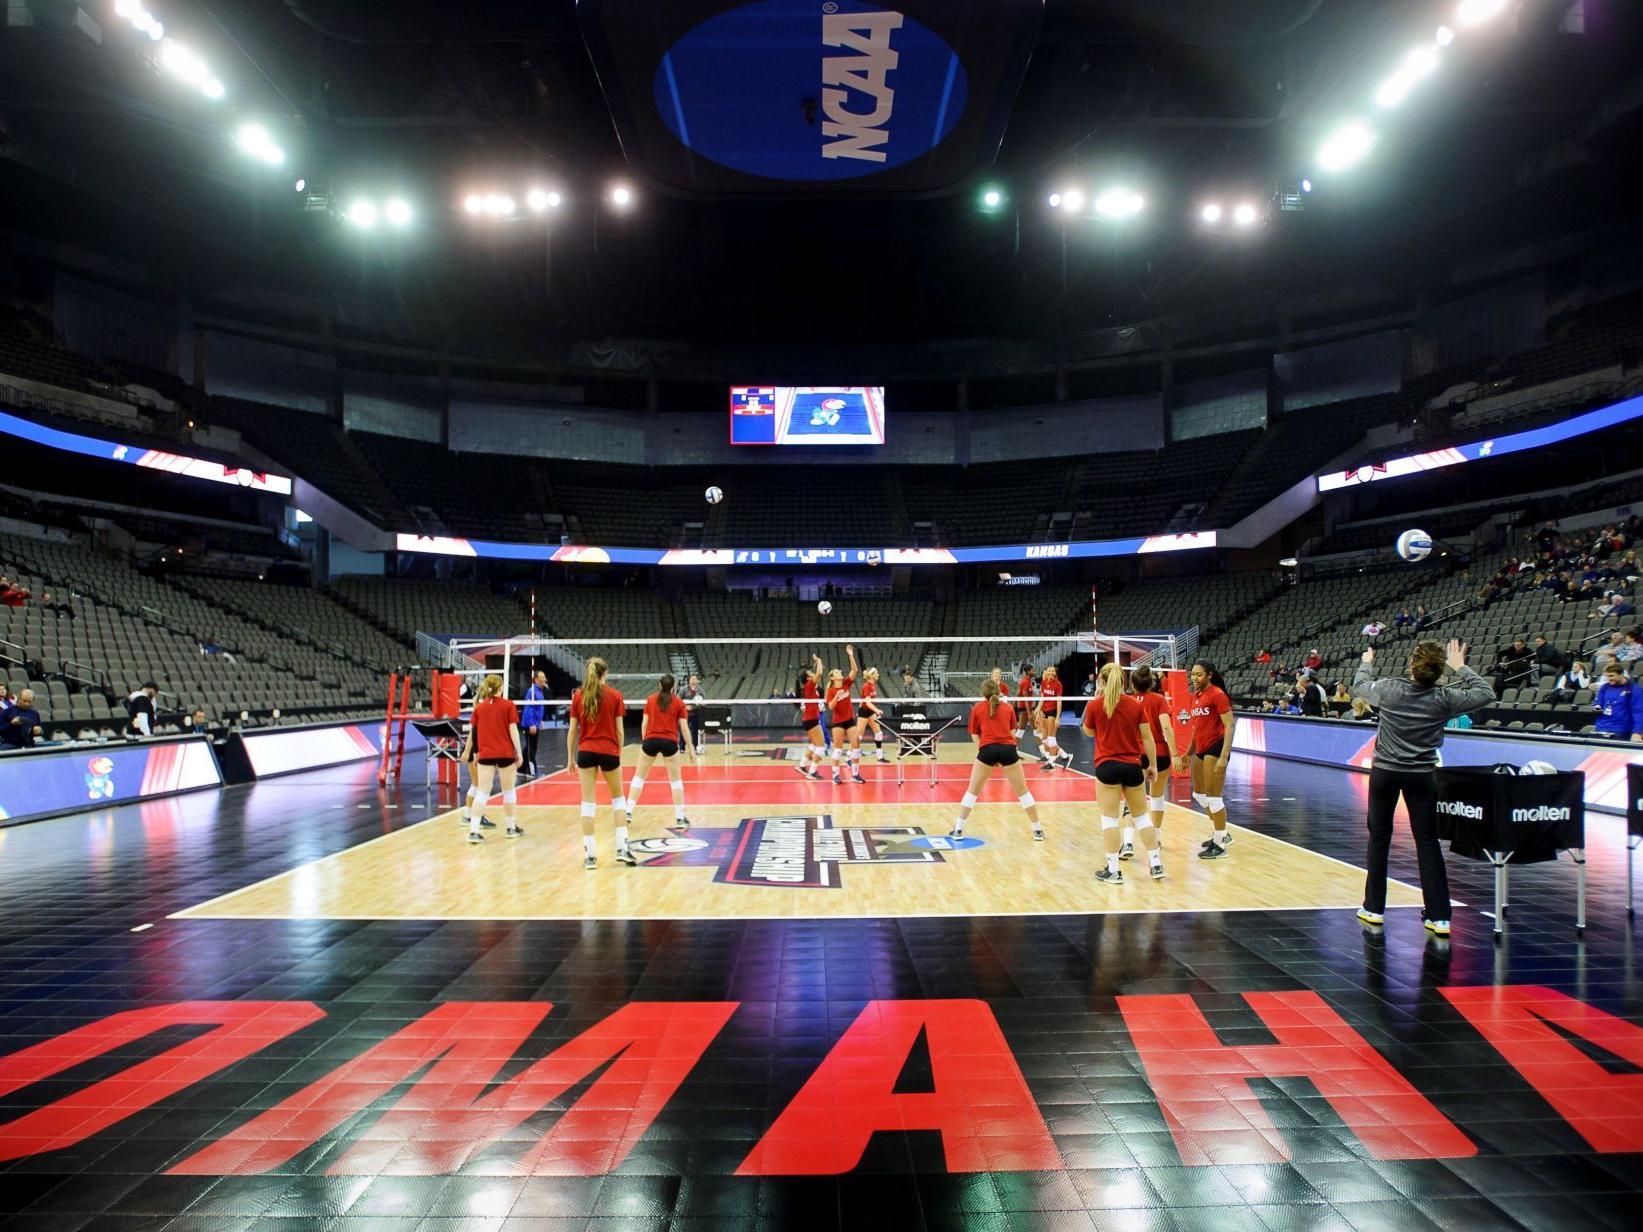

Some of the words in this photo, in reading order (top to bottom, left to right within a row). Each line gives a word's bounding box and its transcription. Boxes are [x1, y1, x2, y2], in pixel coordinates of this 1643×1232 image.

[822, 11, 904, 162] NCAA
[1026, 545, 1069, 558] KANSAS
[900, 722, 931, 730] molten
[1436, 800, 1484, 820] molten
[1512, 805, 1571, 822] molten
[750, 819, 806, 882] CHAMPIONSHIP
[0, 984, 1643, 1176] OMAHA
